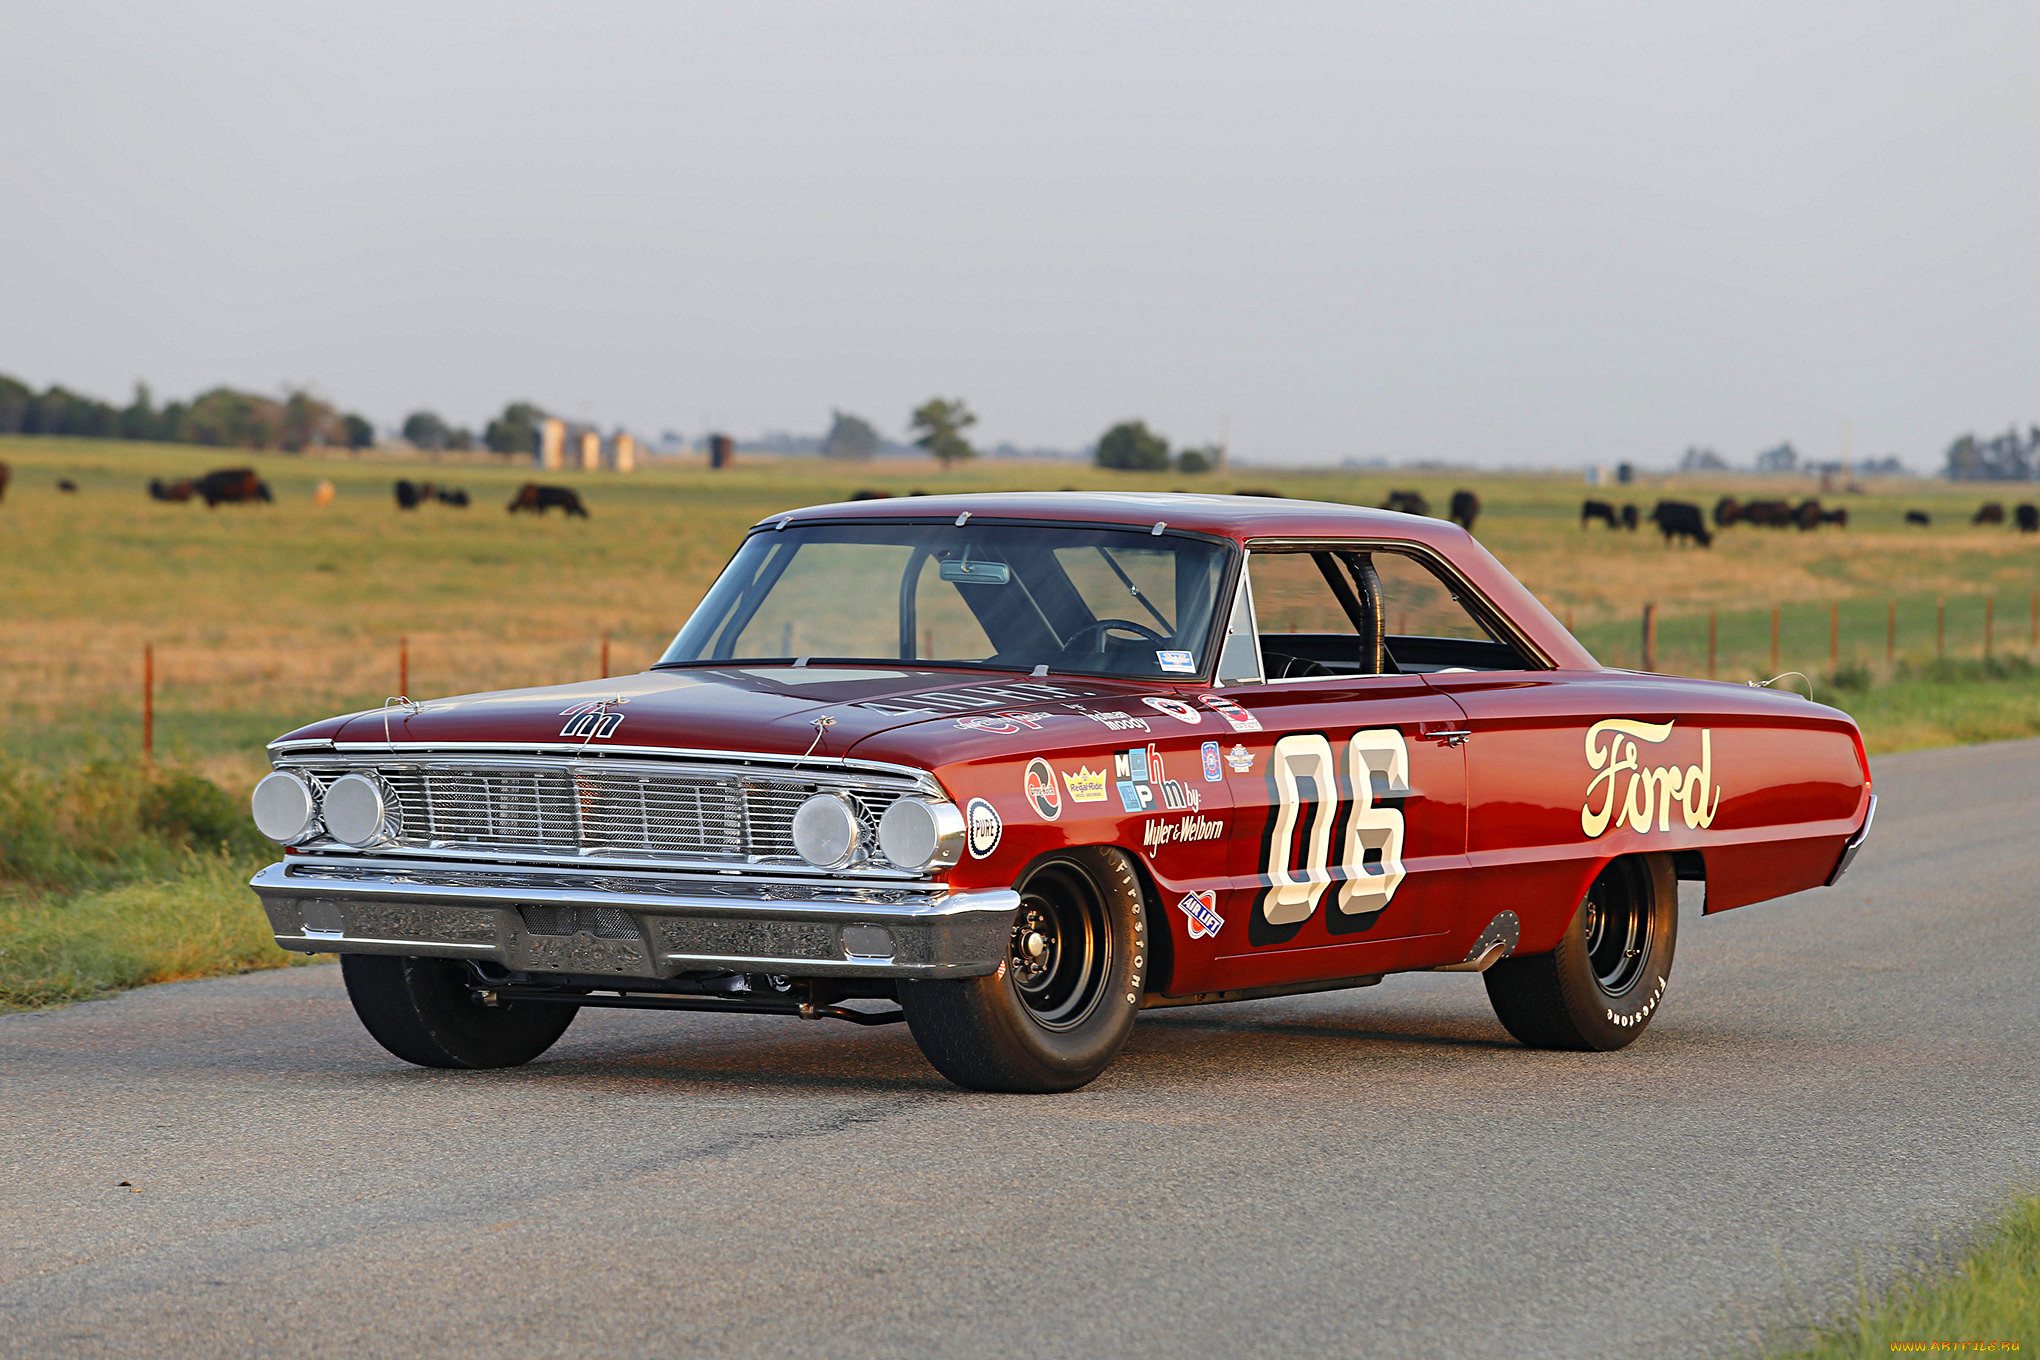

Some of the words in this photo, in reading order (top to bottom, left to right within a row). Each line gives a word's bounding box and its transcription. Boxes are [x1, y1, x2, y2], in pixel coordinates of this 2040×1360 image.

[858, 692, 1006, 717] 410
[1100, 717, 1151, 733] moody
[1581, 717, 1721, 838] Ford
[975, 818, 994, 837] PURE
[1143, 818, 1175, 858] Myler
[1179, 814, 1224, 842] Welborn
[1263, 728, 1409, 925] 06
[1182, 897, 1202, 917] AIR
[1198, 909, 1221, 931] LIFT
